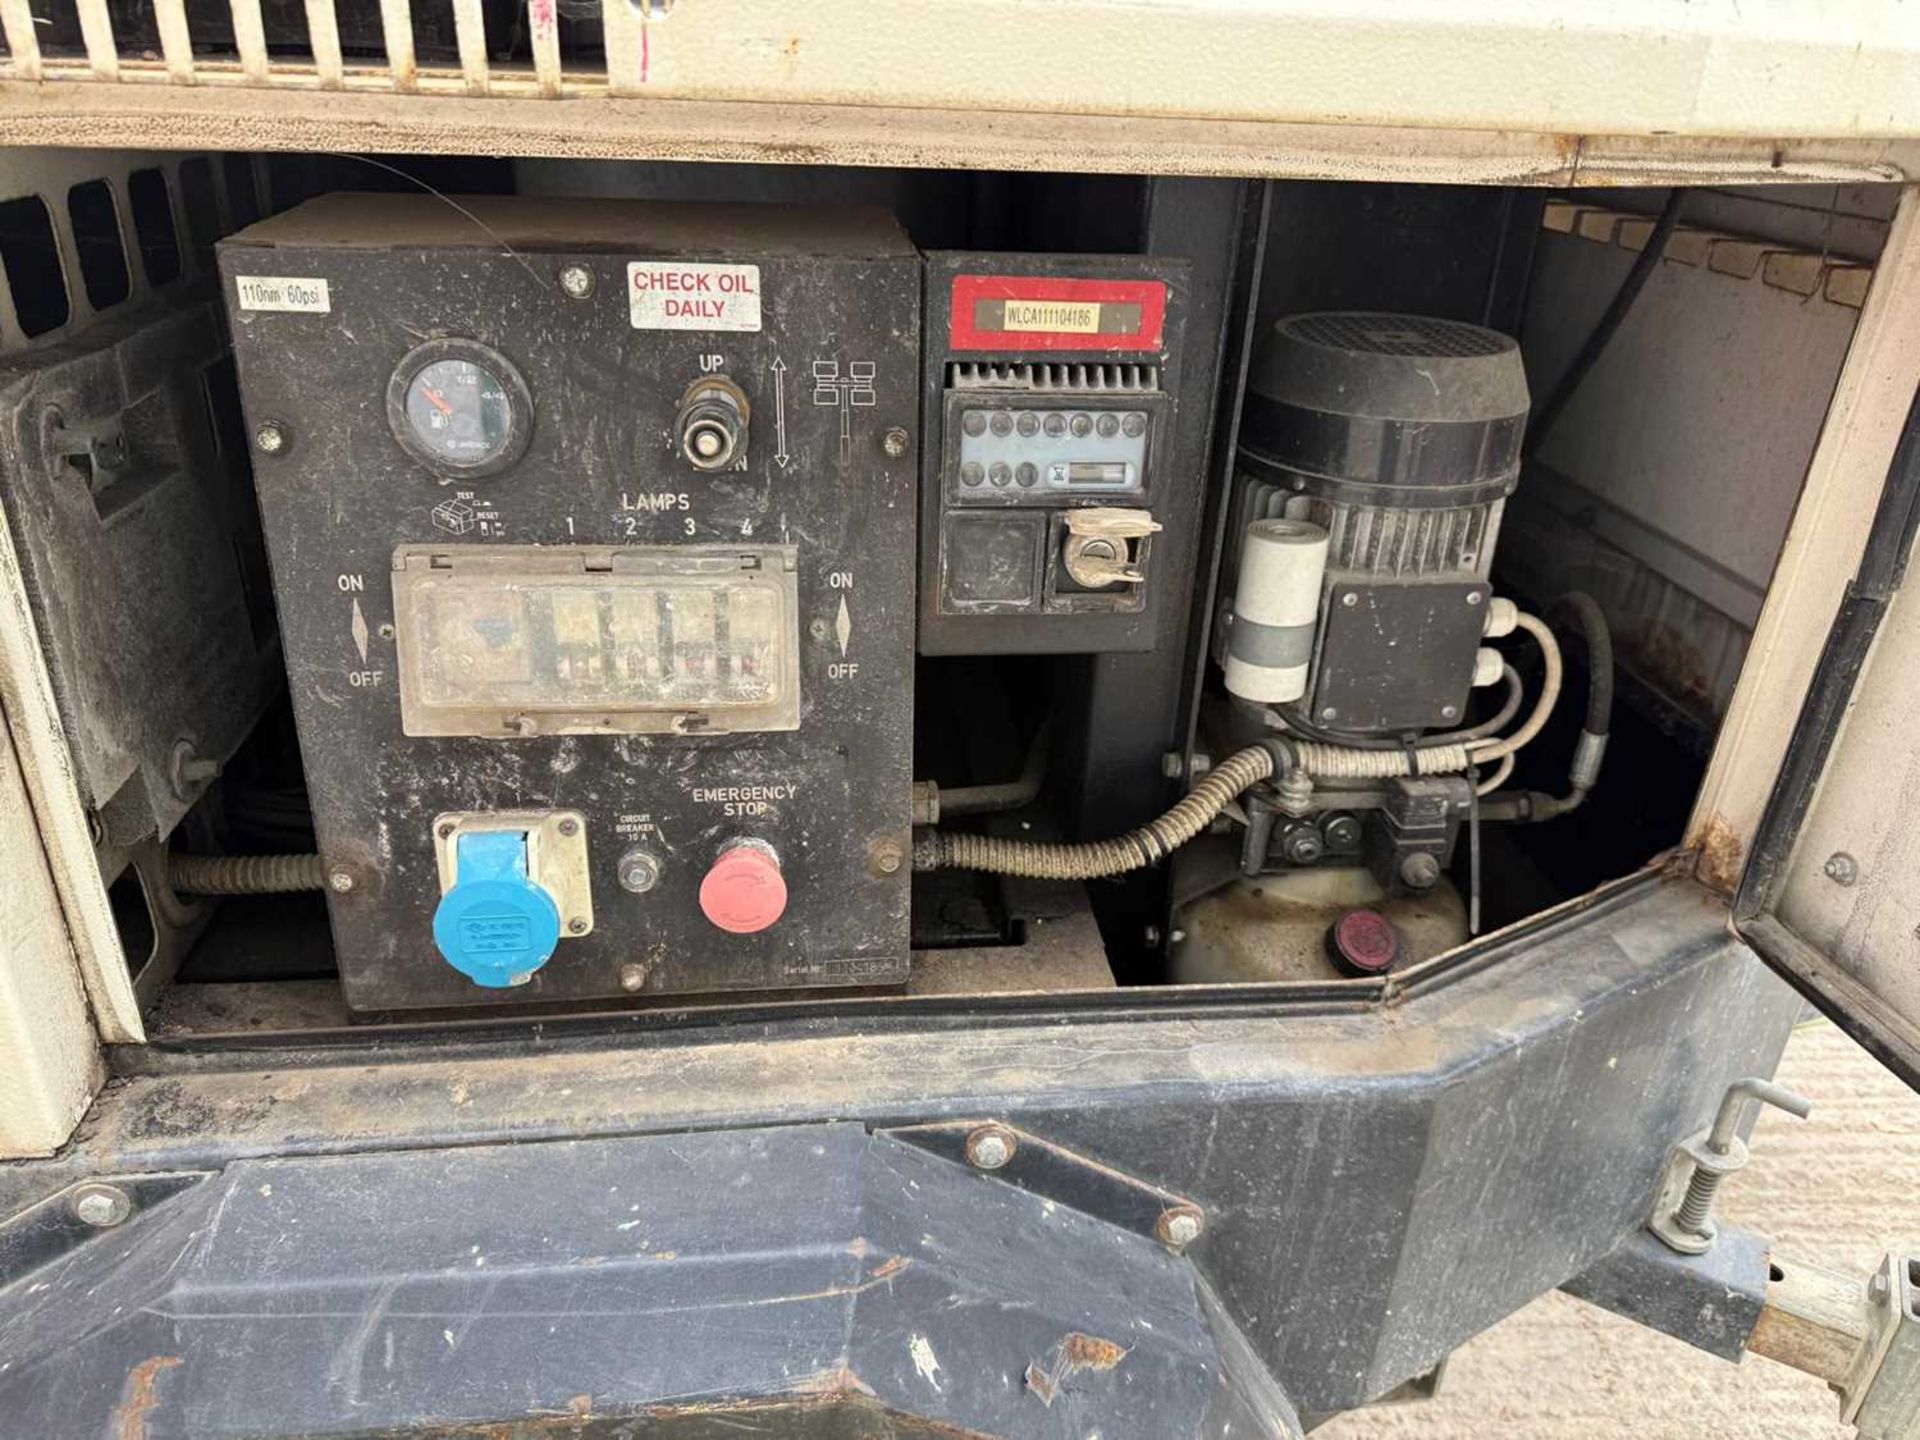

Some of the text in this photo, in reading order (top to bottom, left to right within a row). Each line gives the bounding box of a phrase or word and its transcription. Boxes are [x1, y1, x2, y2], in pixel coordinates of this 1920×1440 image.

[634, 271, 754, 294] CHECK OIL
[242, 283, 320, 306] 110nm 60psi
[664, 299, 725, 318] DAILY
[699, 354, 724, 372] UP
[622, 493, 690, 511] LAMPS
[566, 517, 753, 536] 1 2 3 4
[337, 574, 364, 592] ON
[830, 572, 853, 589] ON
[349, 670, 383, 687] OFF
[827, 663, 859, 680] OFF
[692, 785, 797, 803] EMERGENCY
[724, 802, 768, 817] STOP
[616, 823, 656, 834] BREAKER
